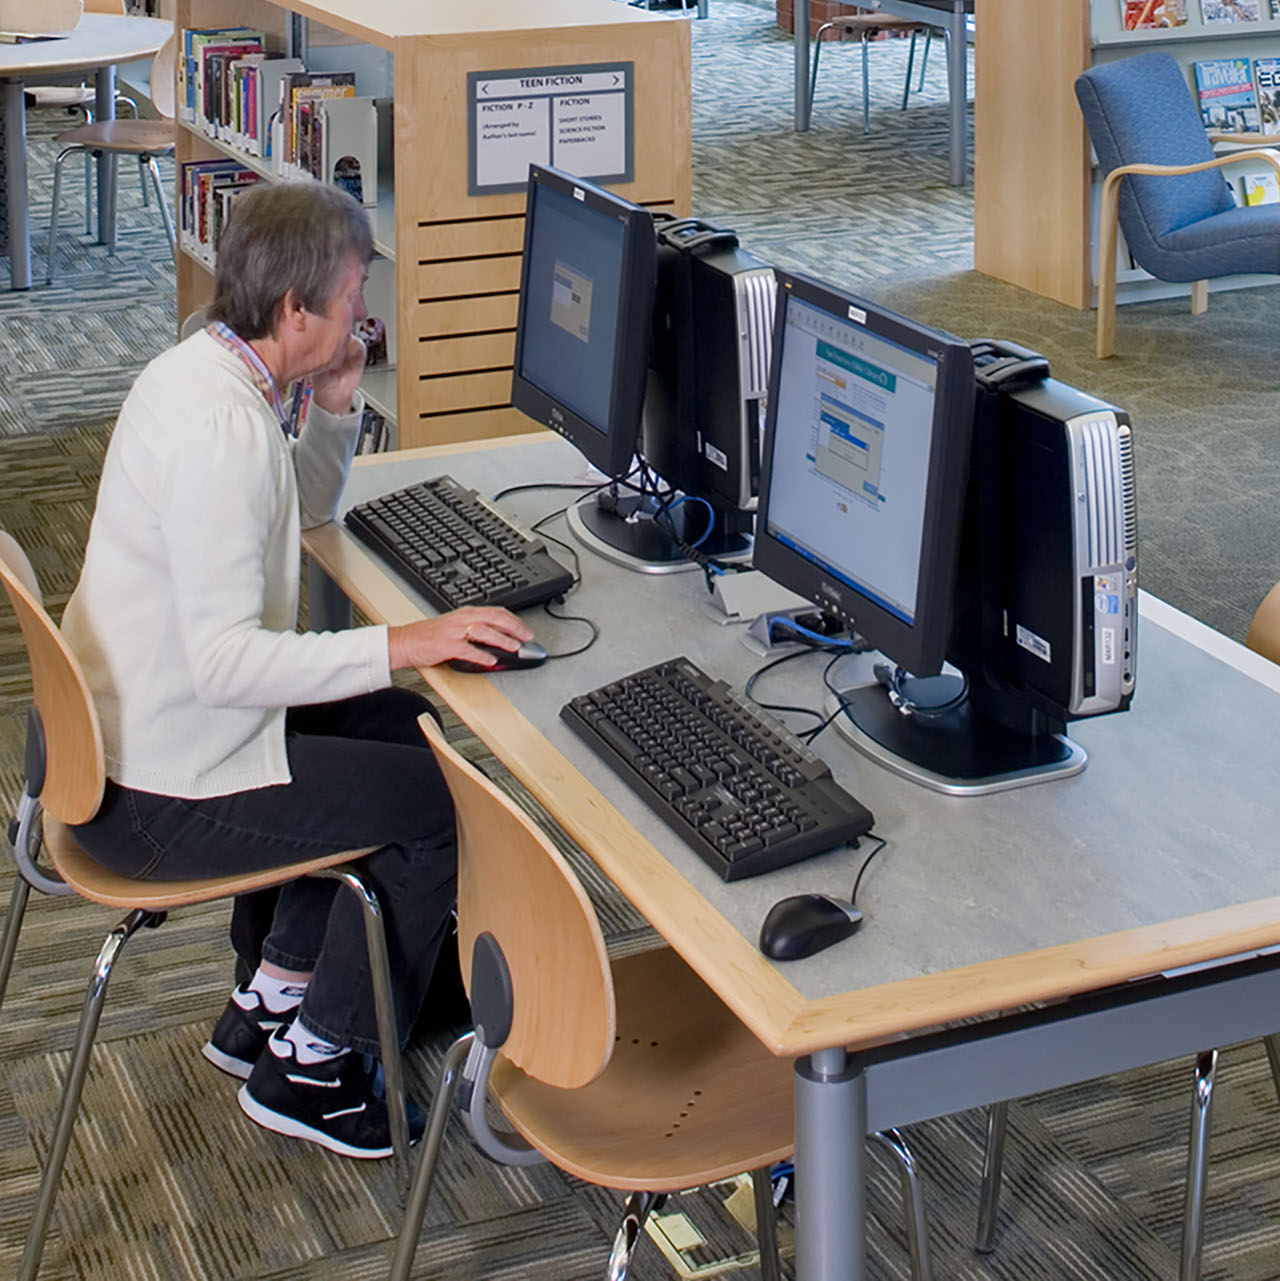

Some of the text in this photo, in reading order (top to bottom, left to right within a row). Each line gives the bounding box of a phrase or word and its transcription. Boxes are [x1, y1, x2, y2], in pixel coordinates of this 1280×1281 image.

[520, 76, 583, 88] TEEN FICTION
[560, 98, 590, 106] FICTION
[482, 104, 513, 112] FICTION
[583, 124, 606, 132] FICTION
[559, 136, 596, 144] PAPERBACKS
